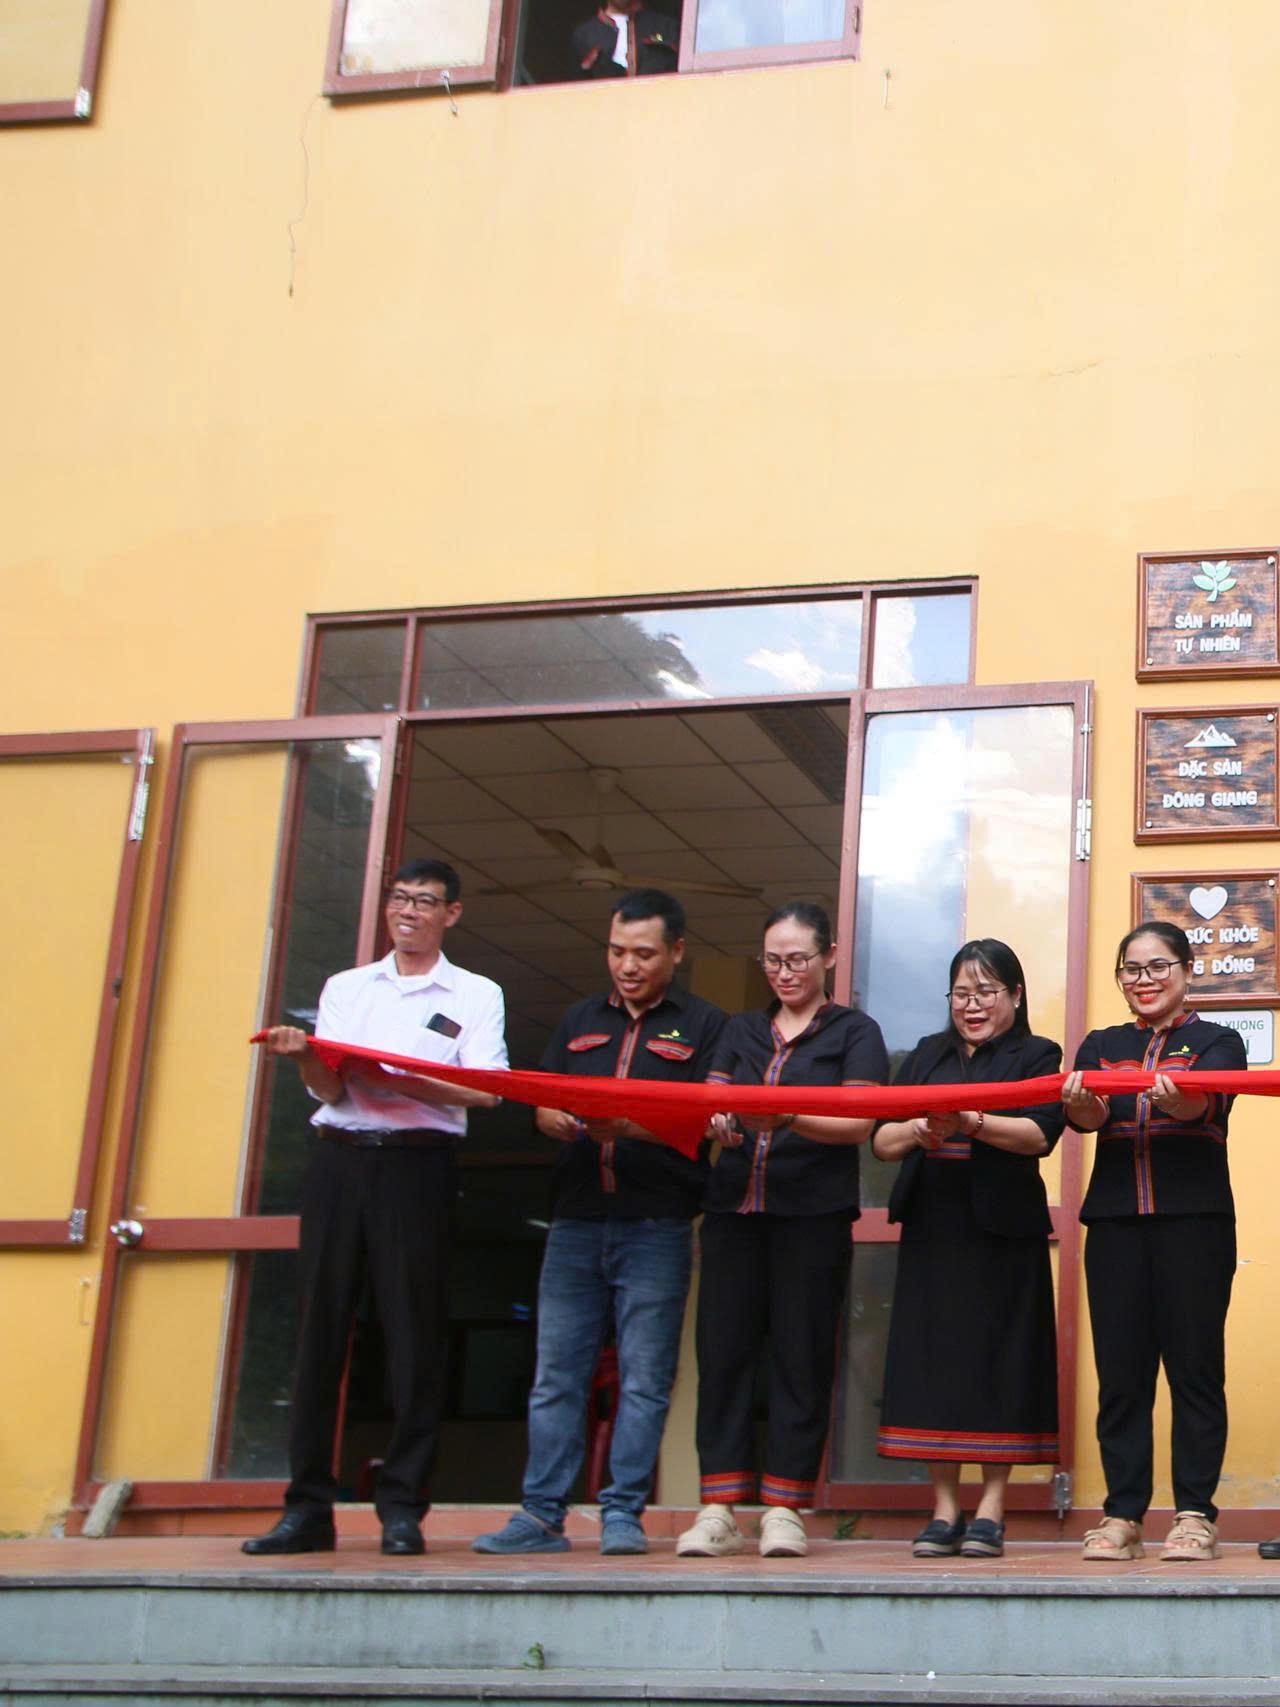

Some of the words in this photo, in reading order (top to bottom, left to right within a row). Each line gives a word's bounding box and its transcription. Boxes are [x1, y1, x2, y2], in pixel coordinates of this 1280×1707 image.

[1175, 612, 1203, 629] SẢN
[1210, 608, 1252, 629] PHẨM
[1174, 637, 1194, 654] TỰ
[1200, 635, 1241, 652] NHIÊN
[1178, 759, 1207, 779] ĐẶC
[1213, 758, 1243, 776] SẢN
[1211, 789, 1258, 807] GIANG
